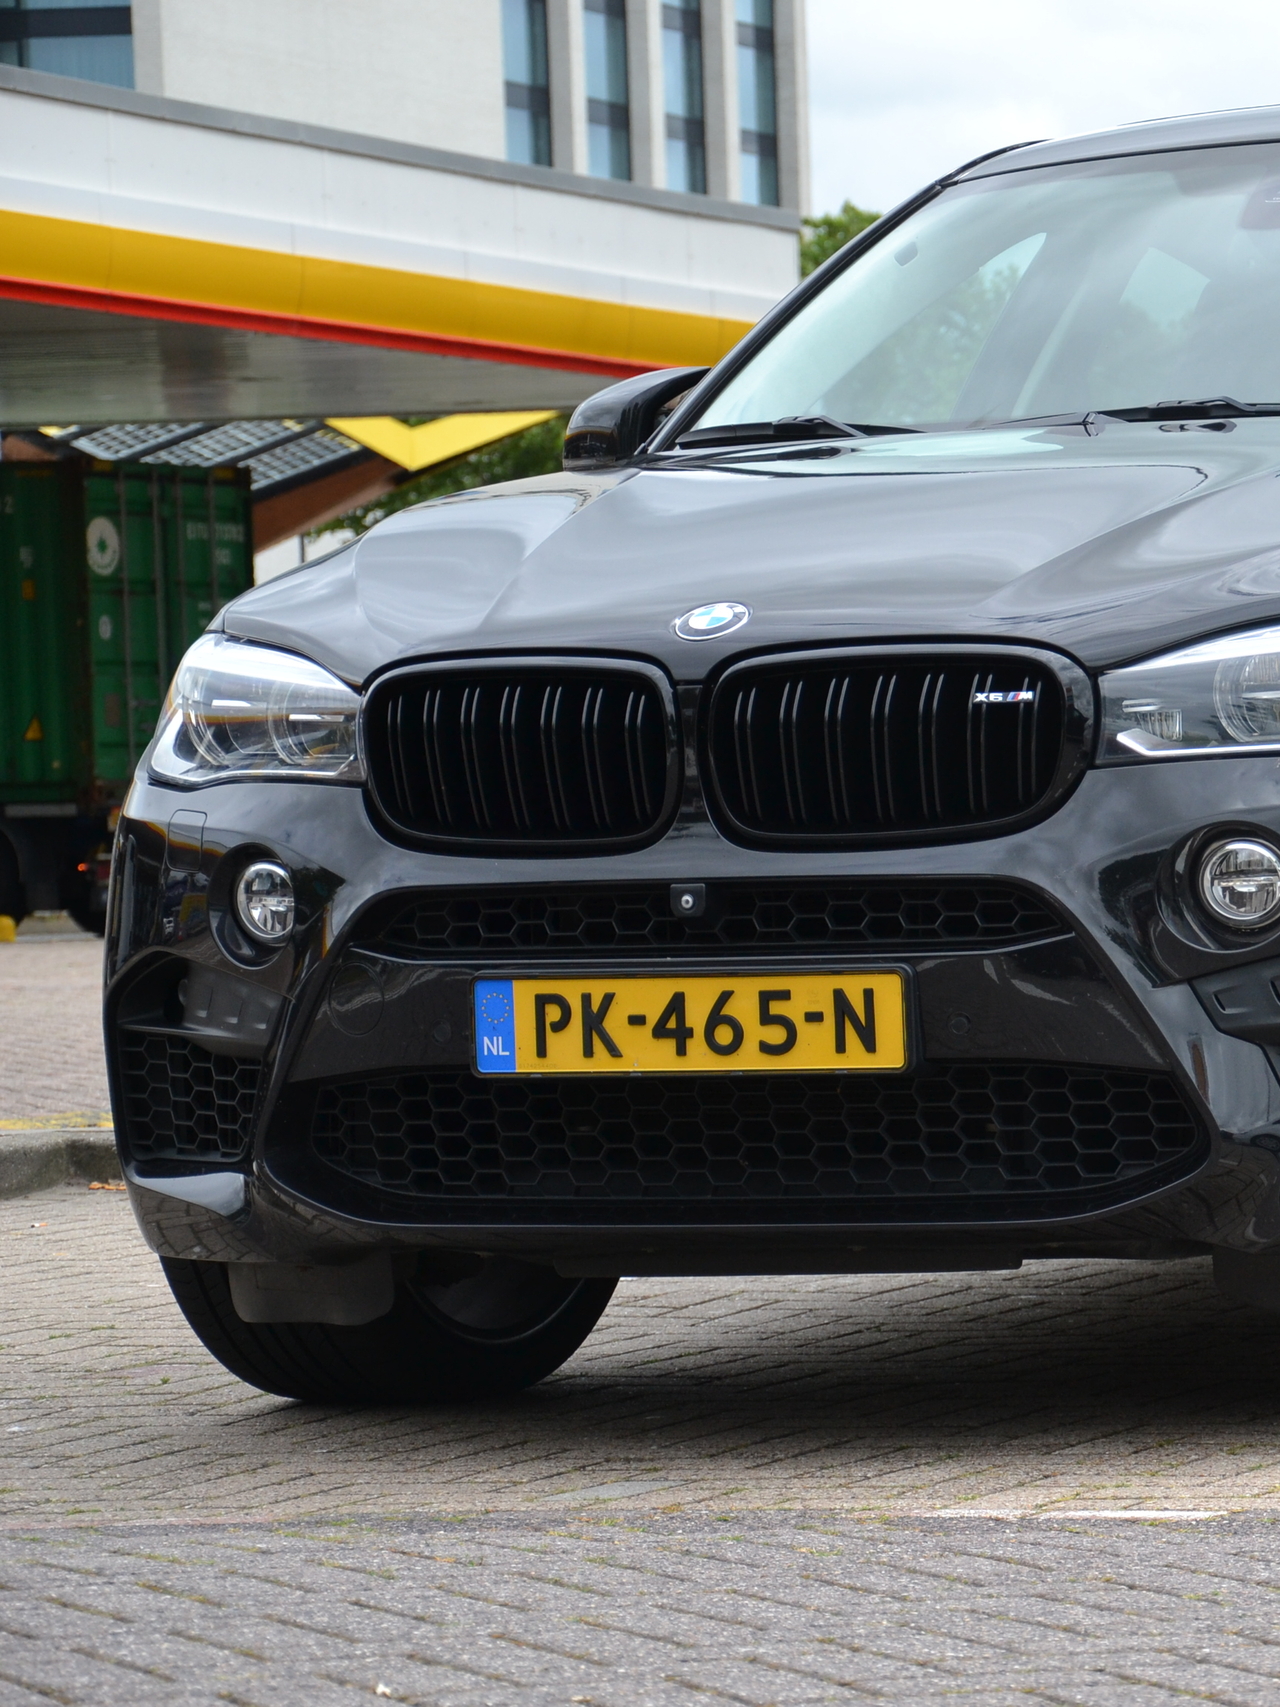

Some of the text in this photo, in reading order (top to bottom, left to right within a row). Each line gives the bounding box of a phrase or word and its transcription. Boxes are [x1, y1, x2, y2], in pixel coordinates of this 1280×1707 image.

[973, 692, 1003, 703] X6
[534, 987, 877, 1059] PK-465-N
[483, 1036, 510, 1056] NL
